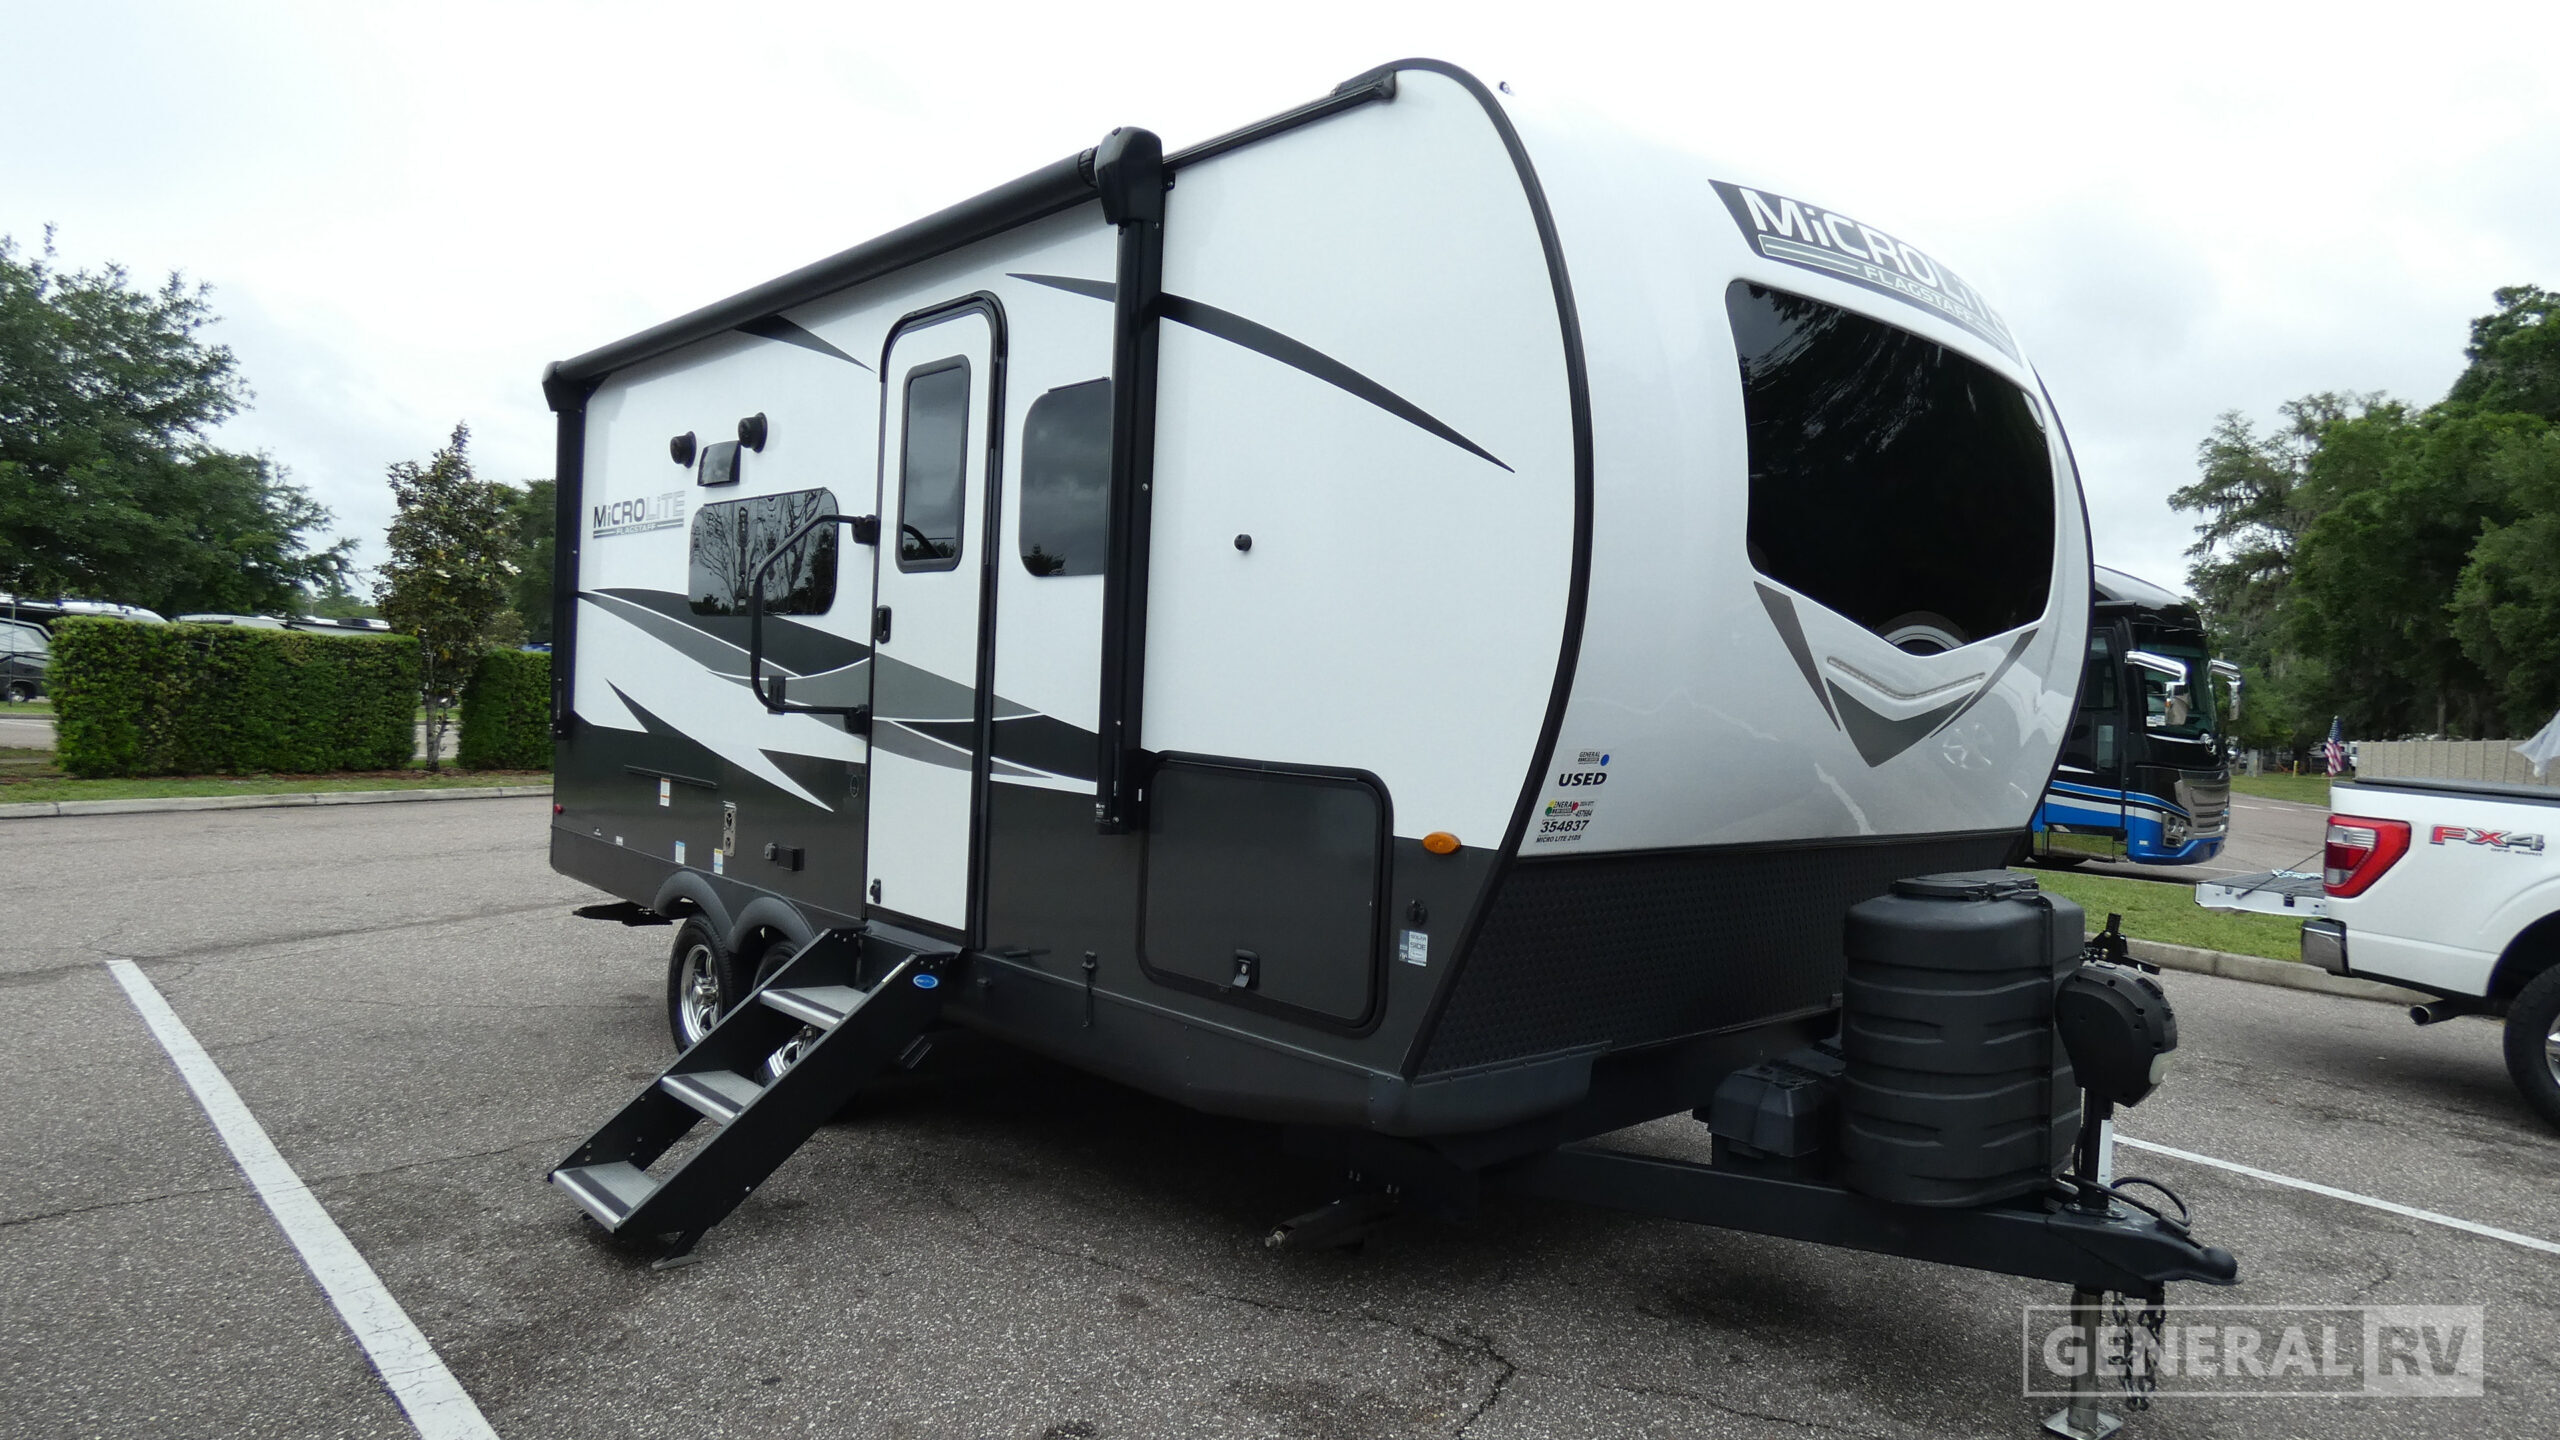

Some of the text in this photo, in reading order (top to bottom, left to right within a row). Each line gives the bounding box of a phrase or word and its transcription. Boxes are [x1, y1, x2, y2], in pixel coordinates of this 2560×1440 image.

[1864, 266, 1975, 323] FLAGSTAFF
[615, 523, 658, 535] FLAGSTAFF
[1558, 772, 1607, 787] USED
[1540, 820, 1590, 833] 354837
[2430, 825, 2545, 851] FX4
